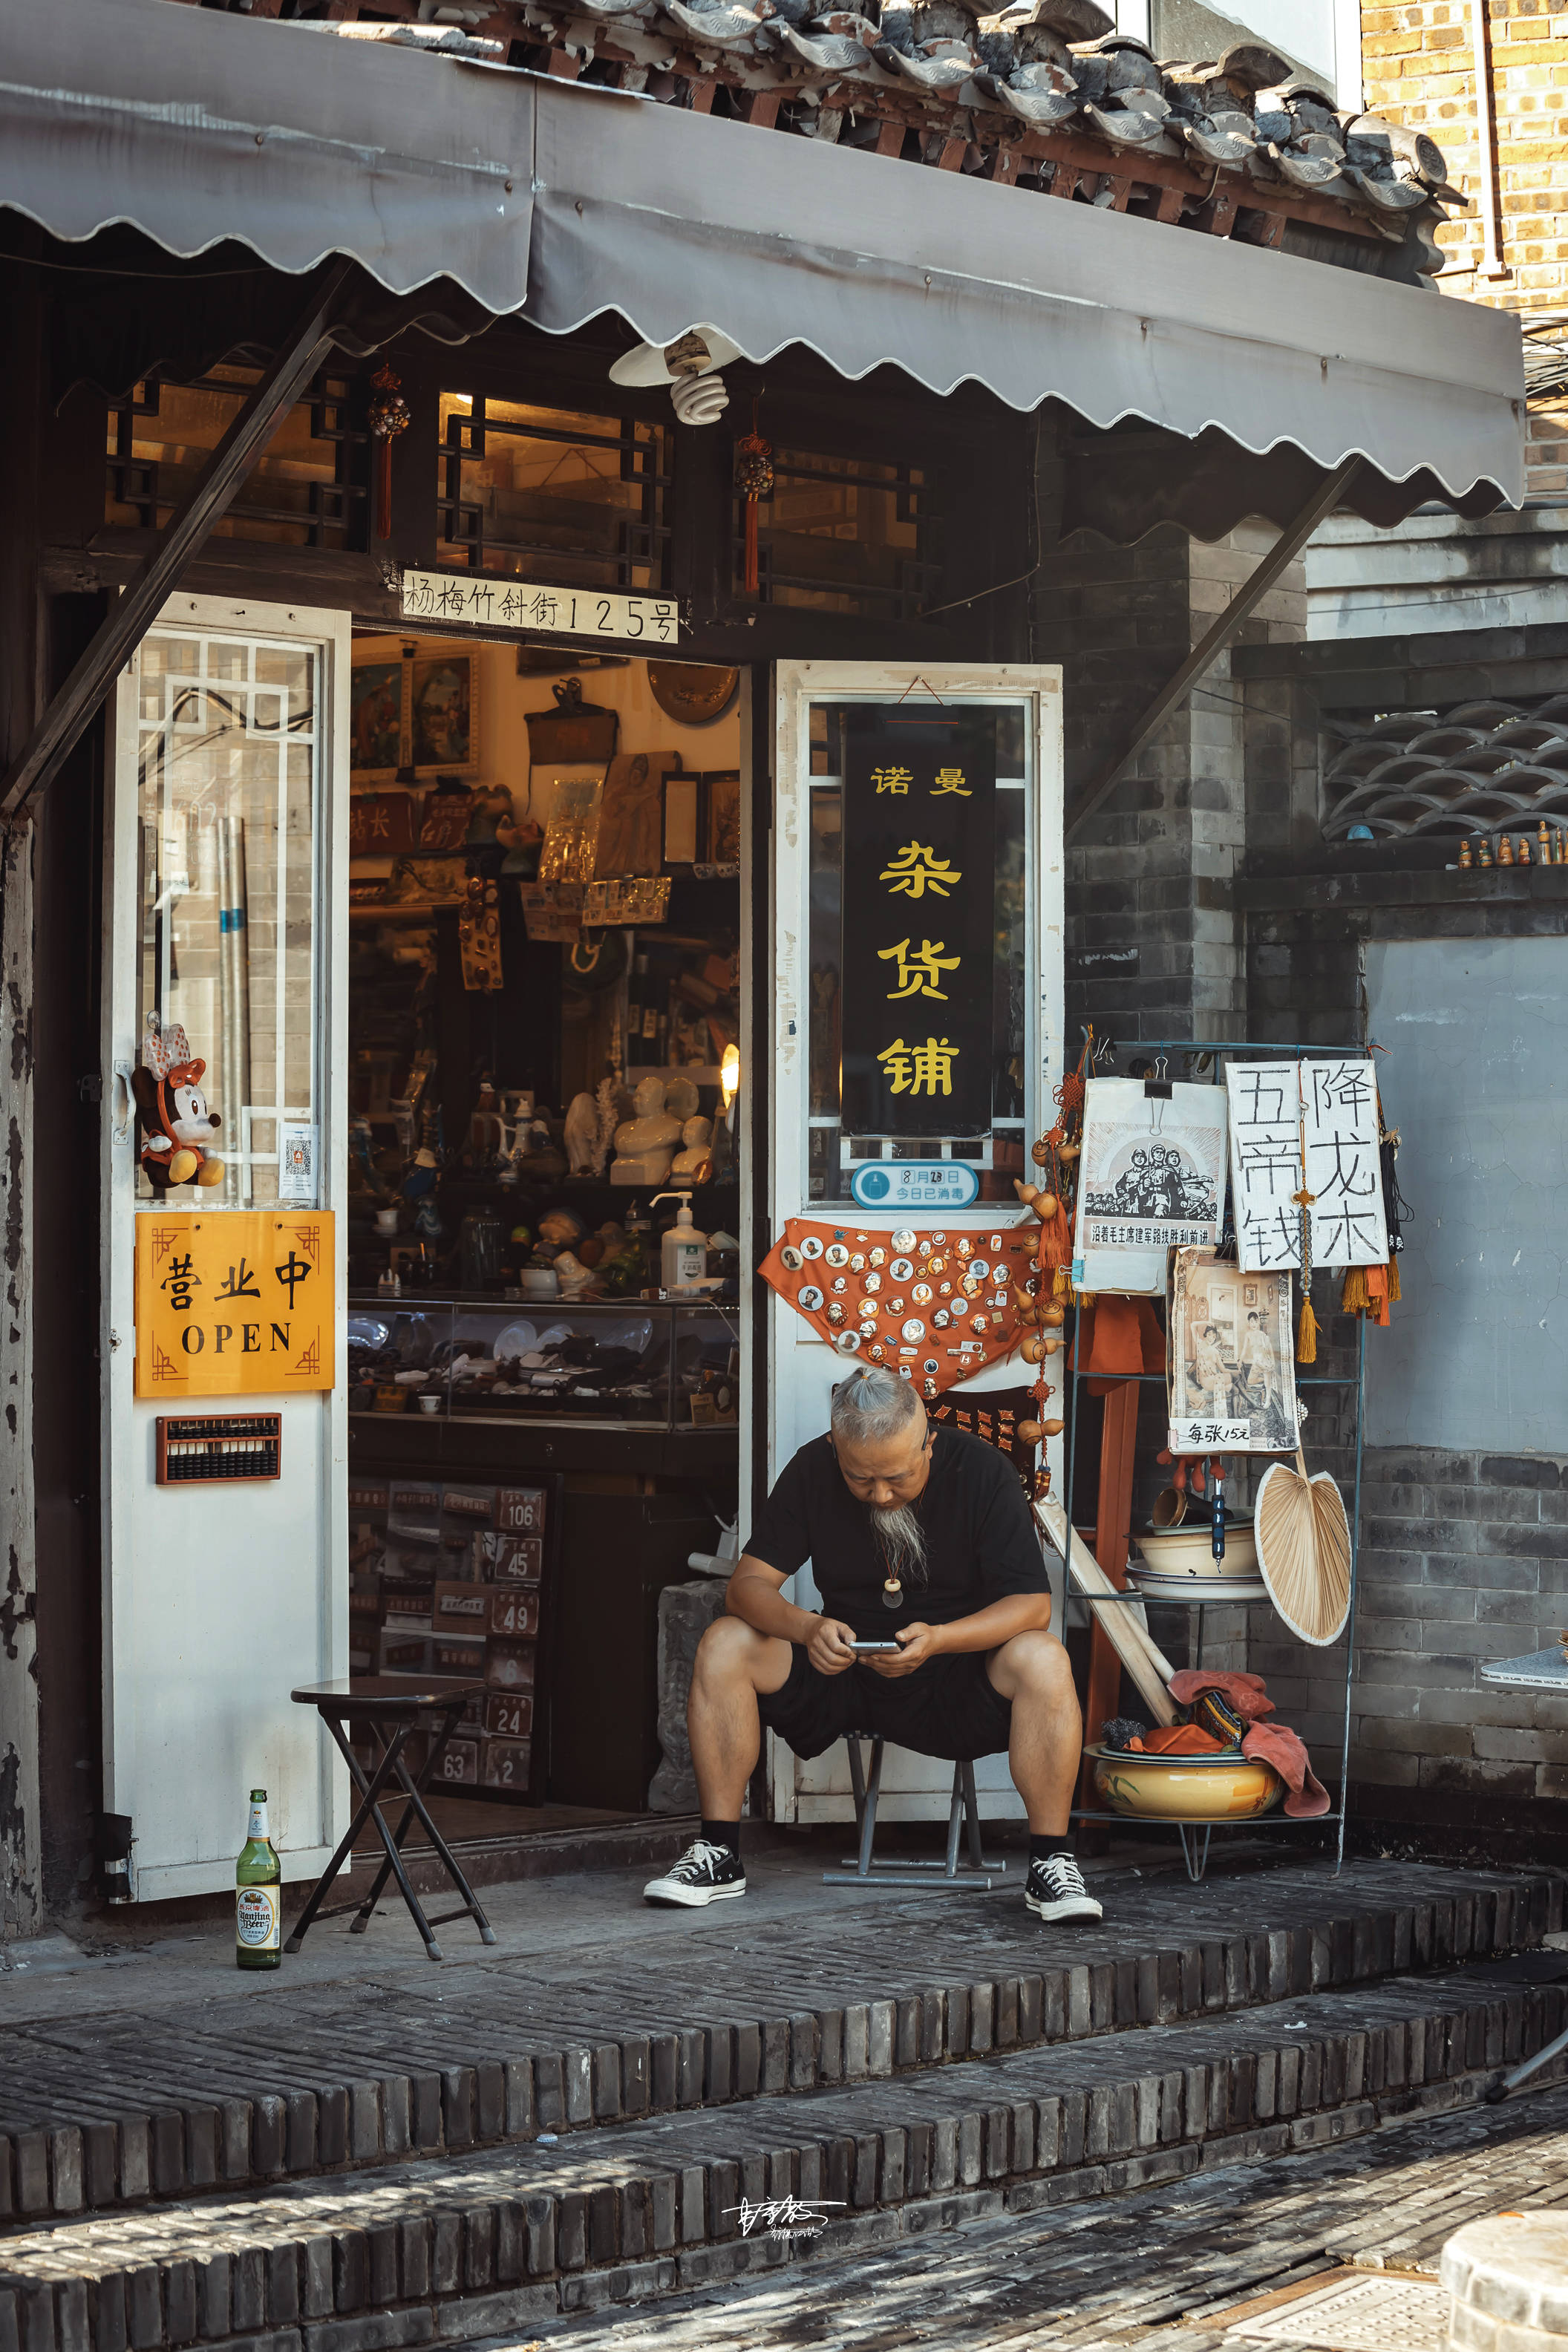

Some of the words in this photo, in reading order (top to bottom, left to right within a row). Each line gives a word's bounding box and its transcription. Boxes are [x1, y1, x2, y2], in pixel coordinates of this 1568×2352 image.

[405, 575, 677, 641] 杨梅竹斜街125号
[870, 766, 973, 797] 诺曼
[877, 840, 962, 1096] 杂货铺
[1237, 1068, 1302, 1267] 五帝钱
[1310, 1062, 1380, 1261] 降龙木
[896, 1187, 964, 1200] 今日已消毒
[1092, 1225, 1209, 1245] 沿着毛主席建军路线胜利前进
[160, 1251, 313, 1311] 营业中
[181, 1322, 292, 1355] OPEN
[1188, 1422, 1250, 1444] 每张15元
[509, 1505, 533, 1527] 106
[507, 1552, 528, 1576] 45
[503, 1606, 528, 1630] 49
[497, 1708, 520, 1734] 24
[444, 1754, 464, 1779] 63
[238, 1910, 271, 1922] Yanjing
[242, 1919, 266, 1930] Beer
